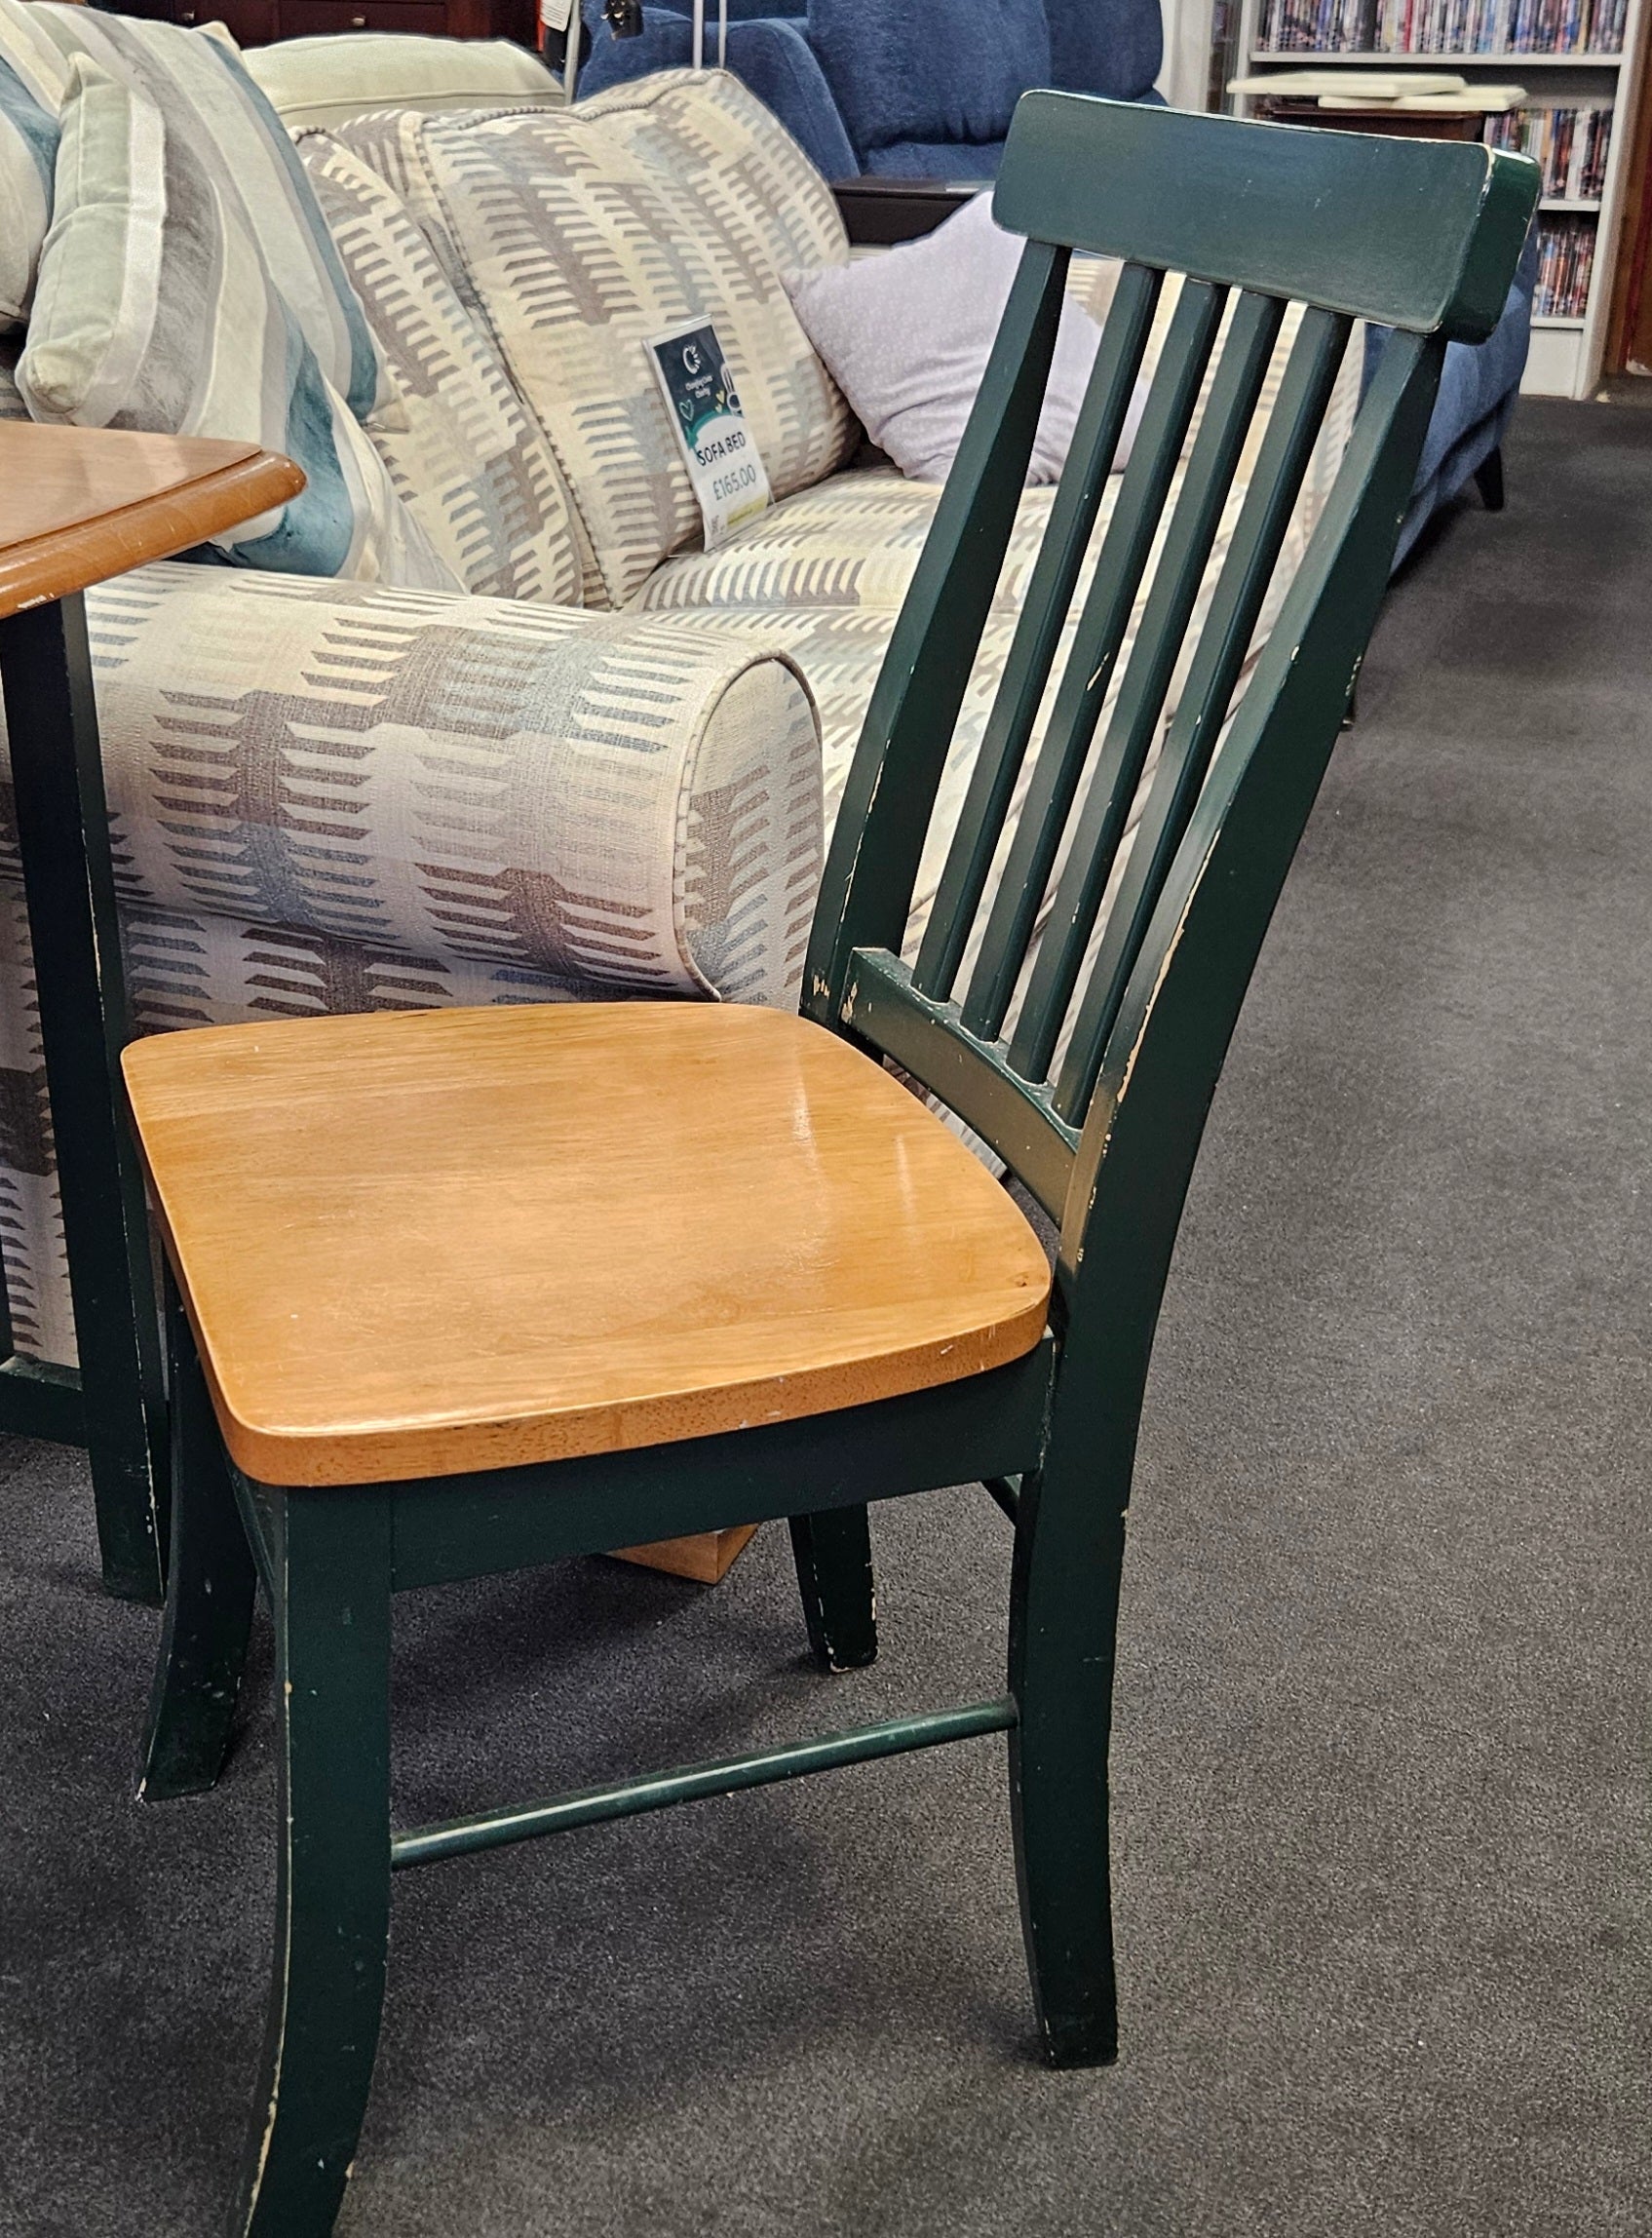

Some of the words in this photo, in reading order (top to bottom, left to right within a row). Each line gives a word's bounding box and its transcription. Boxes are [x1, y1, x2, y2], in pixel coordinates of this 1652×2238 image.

[697, 441, 726, 466] SOFA
[725, 431, 747, 453] BED
[712, 464, 756, 501] £165.00
